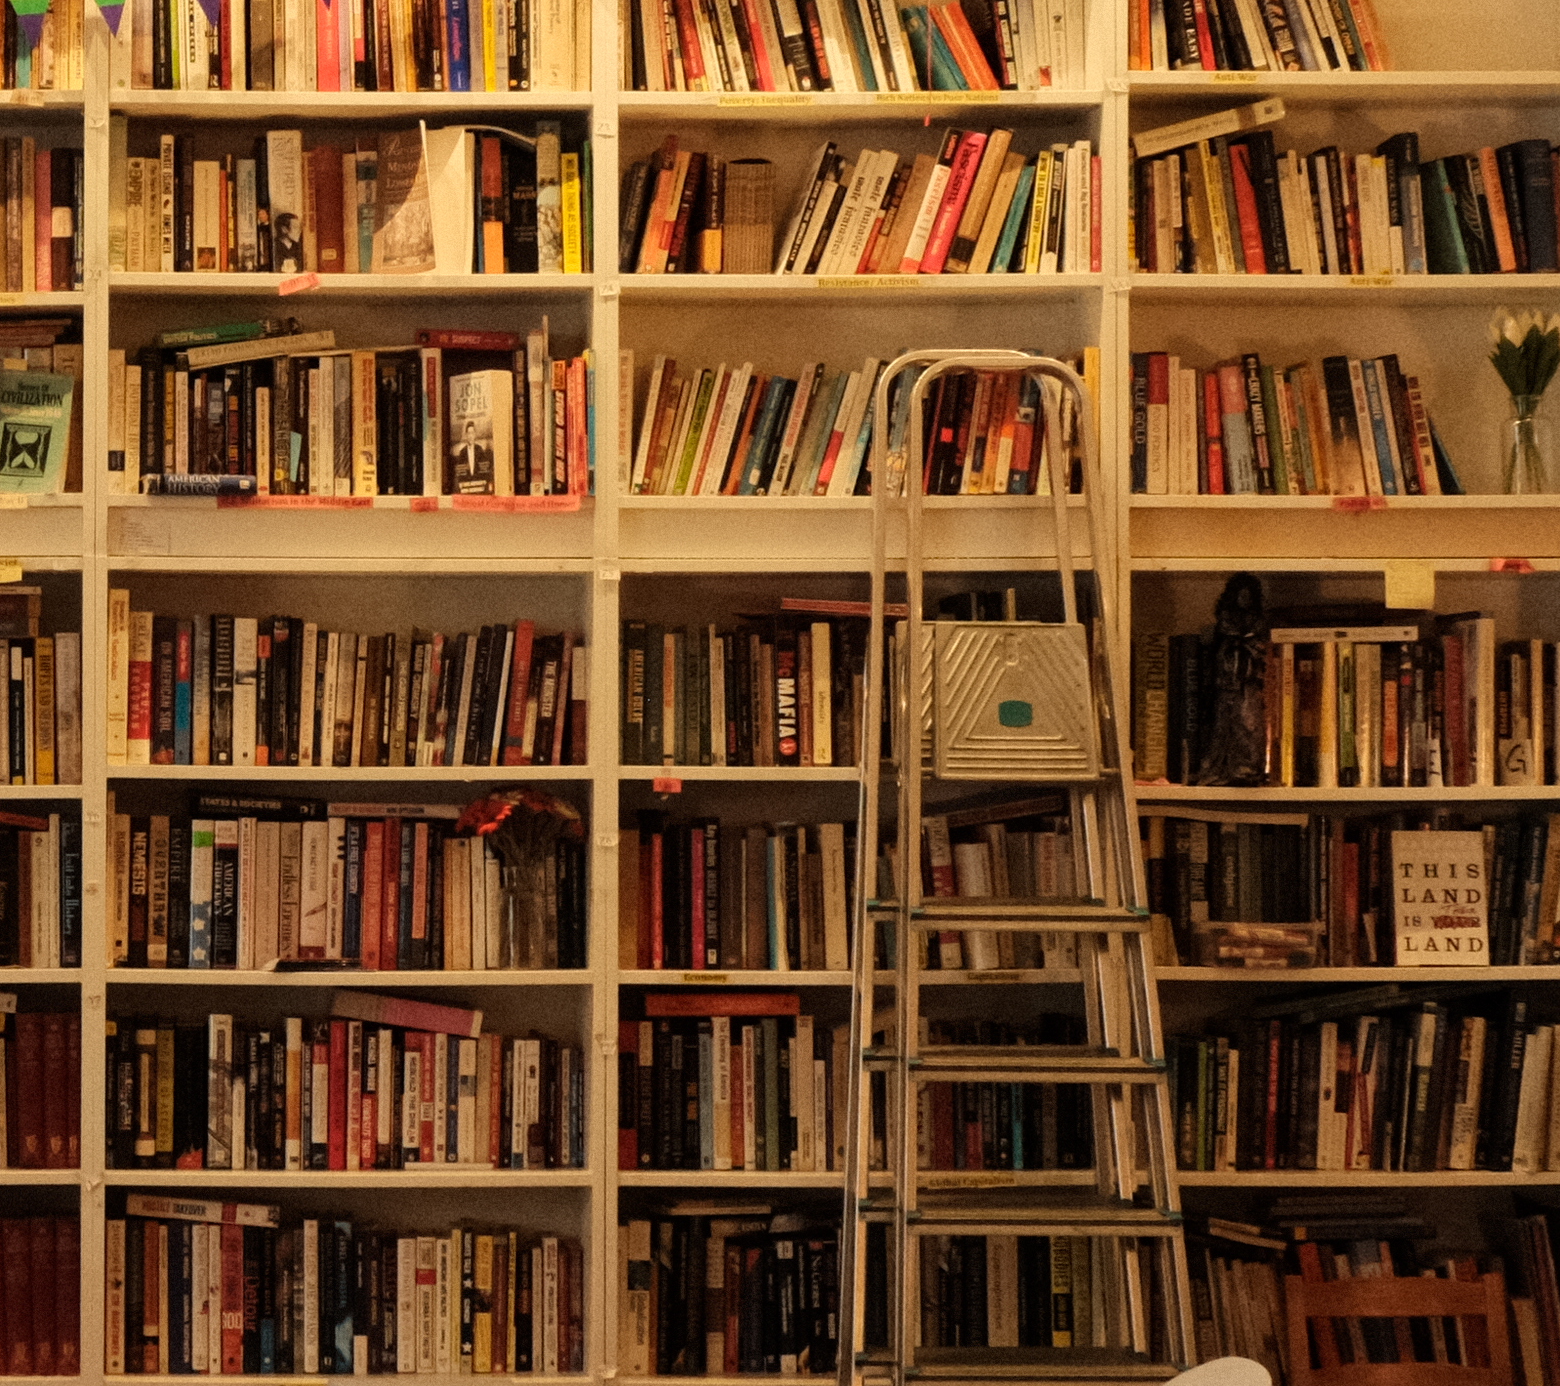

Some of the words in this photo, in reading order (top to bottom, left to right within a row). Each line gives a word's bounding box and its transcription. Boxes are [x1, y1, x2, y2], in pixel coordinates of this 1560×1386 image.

[128, 169, 142, 207] EMPIRE
[459, 383, 477, 397] JON
[1134, 377, 1147, 410] BLUE
[455, 399, 489, 413] SOPEL
[1134, 411, 1147, 444] GOLD
[167, 475, 221, 484] AMERICAN
[167, 484, 220, 494] HISTORY
[160, 657, 172, 708] AMERICAN
[200, 797, 231, 807] STATES
[132, 832, 147, 896] NEMESIS
[1399, 864, 1481, 878] THIS
[283, 854, 296, 900] Endless
[223, 861, 233, 916] AMERICAN
[1402, 889, 1482, 903] LAND
[1403, 915, 1422, 927] IS
[1405, 937, 1484, 953] LAND
[244, 1275, 258, 1331] Detour
